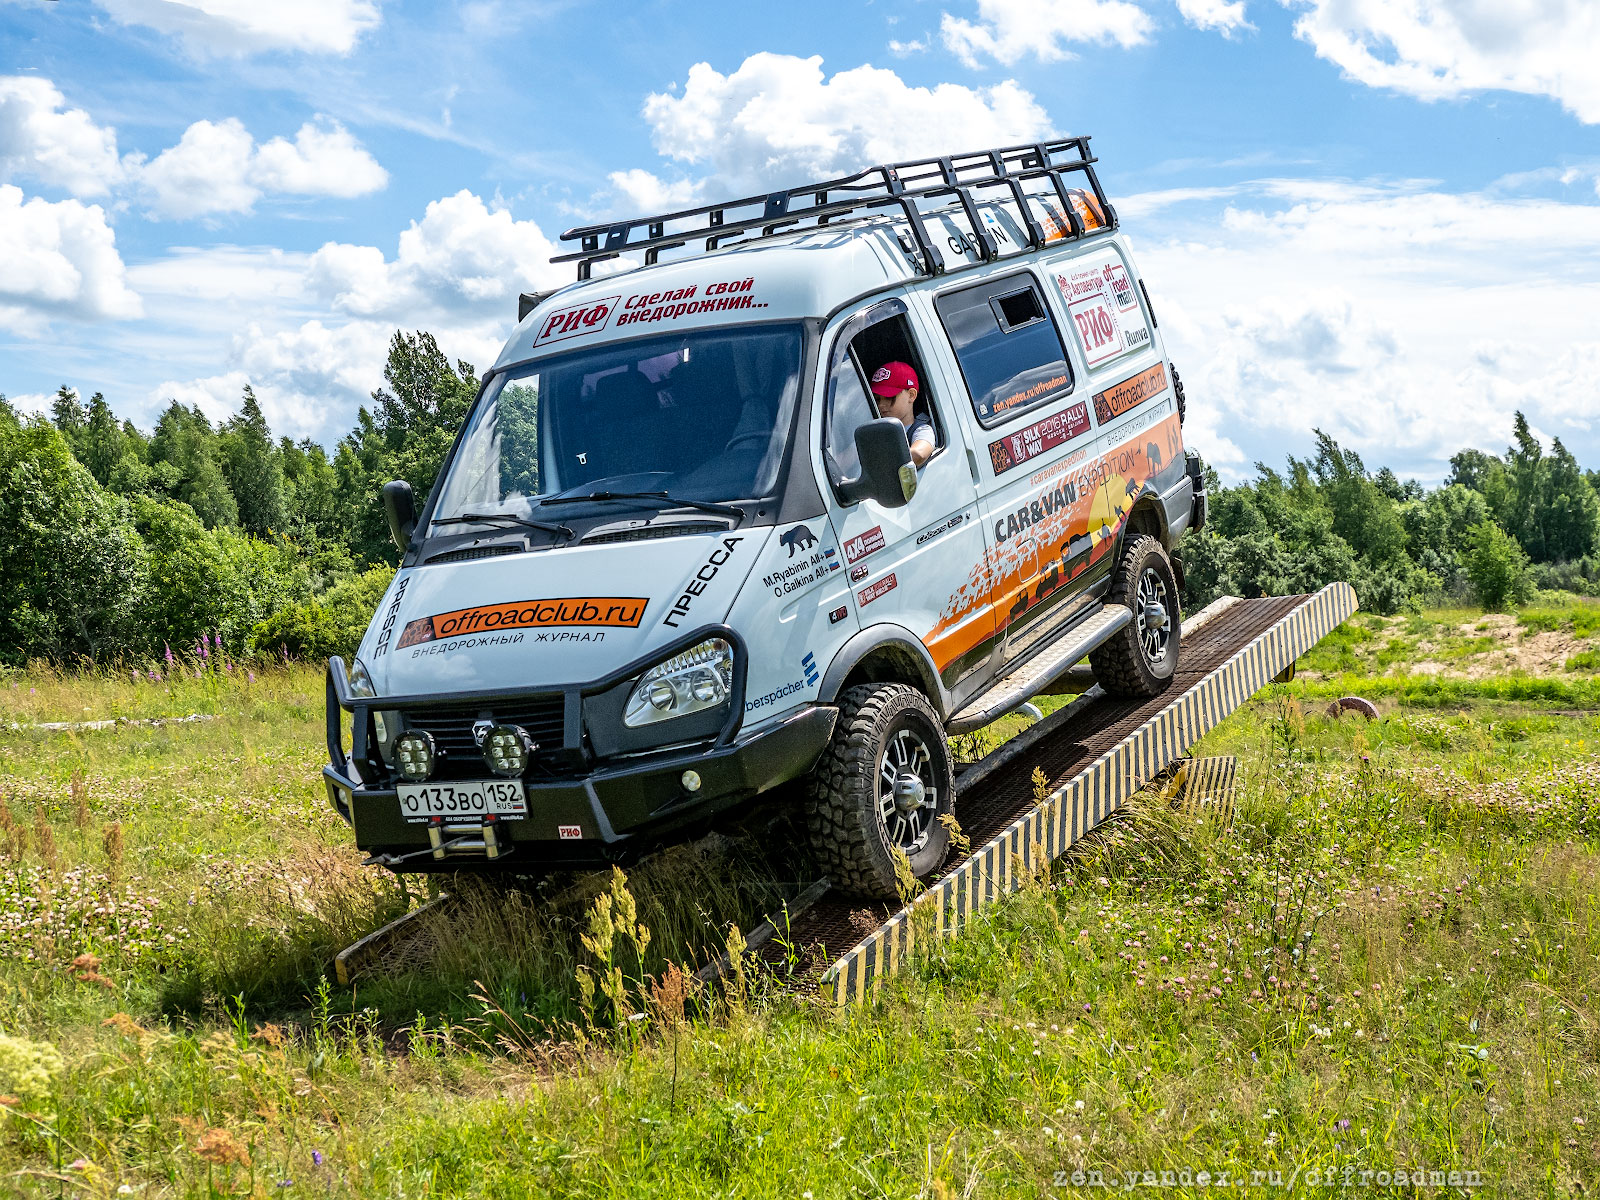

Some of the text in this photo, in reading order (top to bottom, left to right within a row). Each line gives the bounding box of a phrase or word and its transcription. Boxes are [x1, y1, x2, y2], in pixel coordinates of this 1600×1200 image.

[948, 225, 1008, 255] GARIN
[1102, 263, 1115, 282] off
[1112, 273, 1128, 294] road
[624, 278, 754, 310] Сделай свой
[1117, 290, 1134, 307] man
[541, 304, 609, 339] РИФ
[616, 295, 769, 327] внедорожник...
[1074, 305, 1113, 352] РИФ
[1124, 327, 1149, 347] Runva
[992, 374, 1068, 414] zen.yandex.ru/offroadman
[1023, 425, 1041, 444] SILK
[1060, 404, 1085, 427] RALLY
[1025, 438, 1043, 457] WAY
[1030, 448, 1088, 487] #caravanexpedition
[994, 449, 1136, 543] CAR&VAN EXPEDITION
[663, 537, 744, 628] ПРЕССА
[763, 560, 811, 588] M.Ryabinin
[774, 574, 815, 599] O.Galkina
[373, 577, 411, 661] PRESSE
[440, 601, 639, 634] offroadclub.ru
[411, 632, 605, 659] ВНЕДОРОЖНЫЙ ЖУРНАЛ
[745, 679, 804, 712] berspächer
[488, 784, 518, 802] 152
[497, 802, 512, 810] RUS
[560, 827, 581, 838] РИФ
